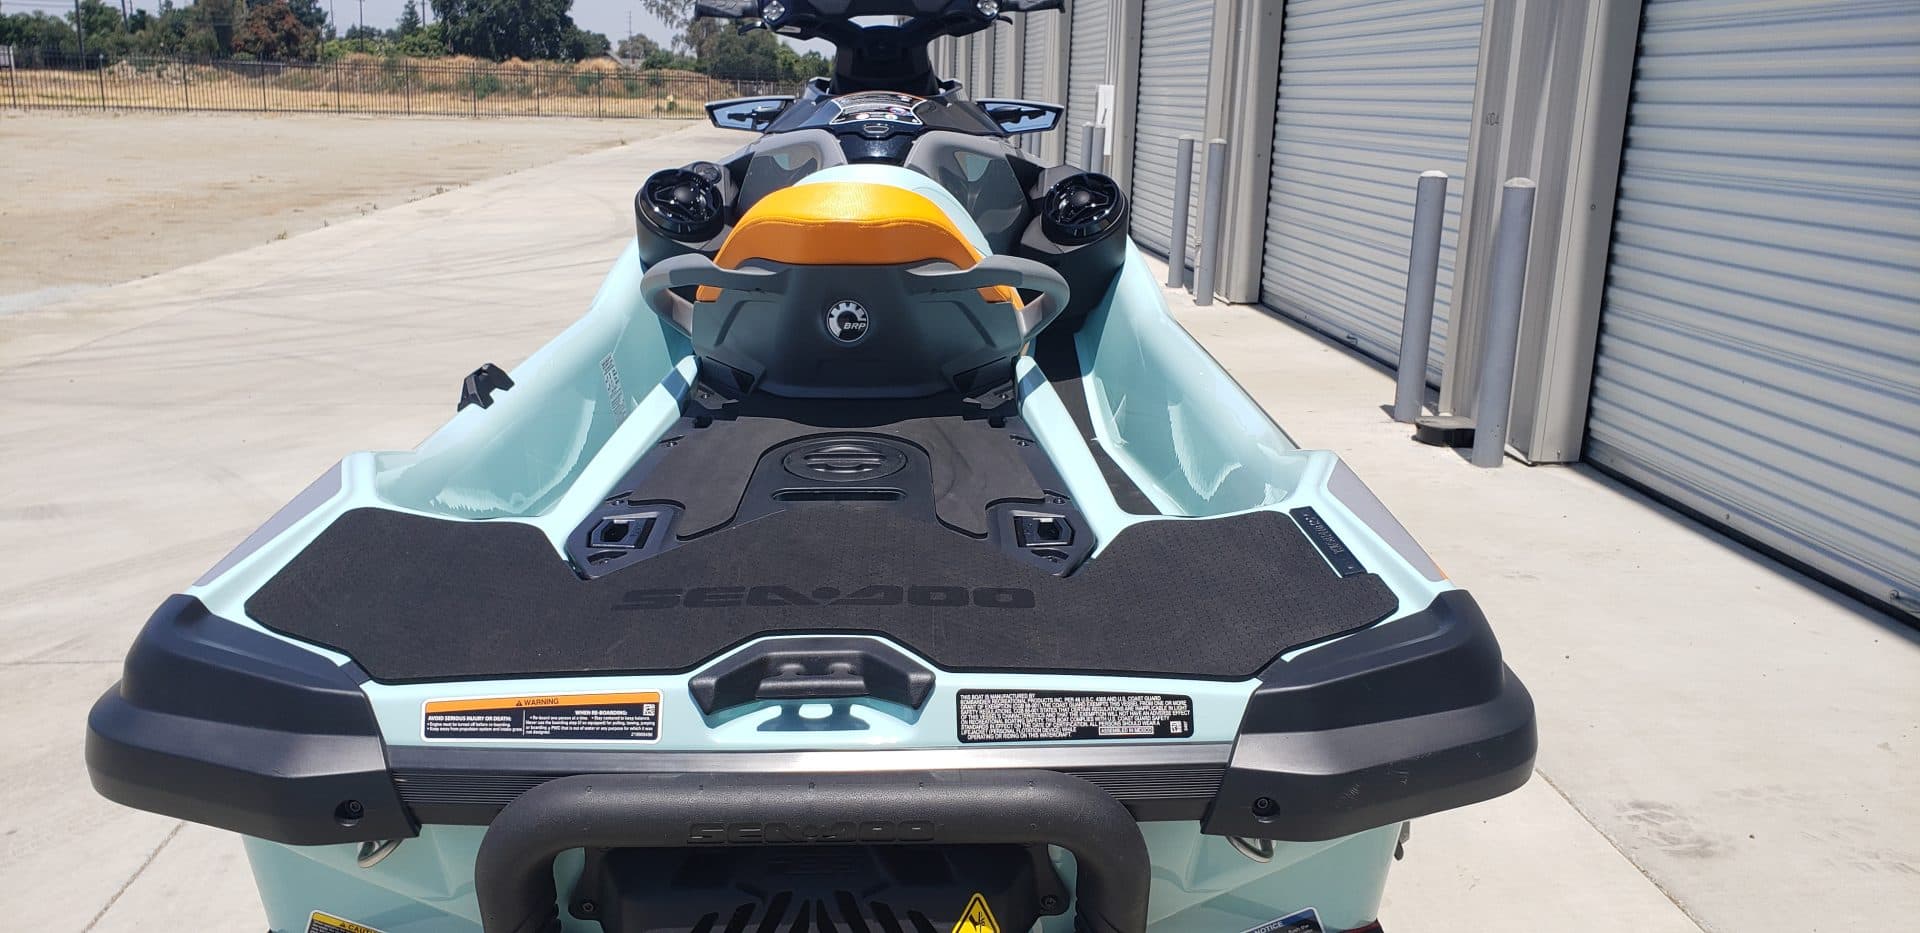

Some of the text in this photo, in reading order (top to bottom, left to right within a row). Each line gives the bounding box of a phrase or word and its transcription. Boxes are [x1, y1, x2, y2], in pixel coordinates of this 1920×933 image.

[843, 322, 866, 330] BRP
[524, 698, 559, 706] WARNING
[1254, 921, 1284, 933] NOTICE
